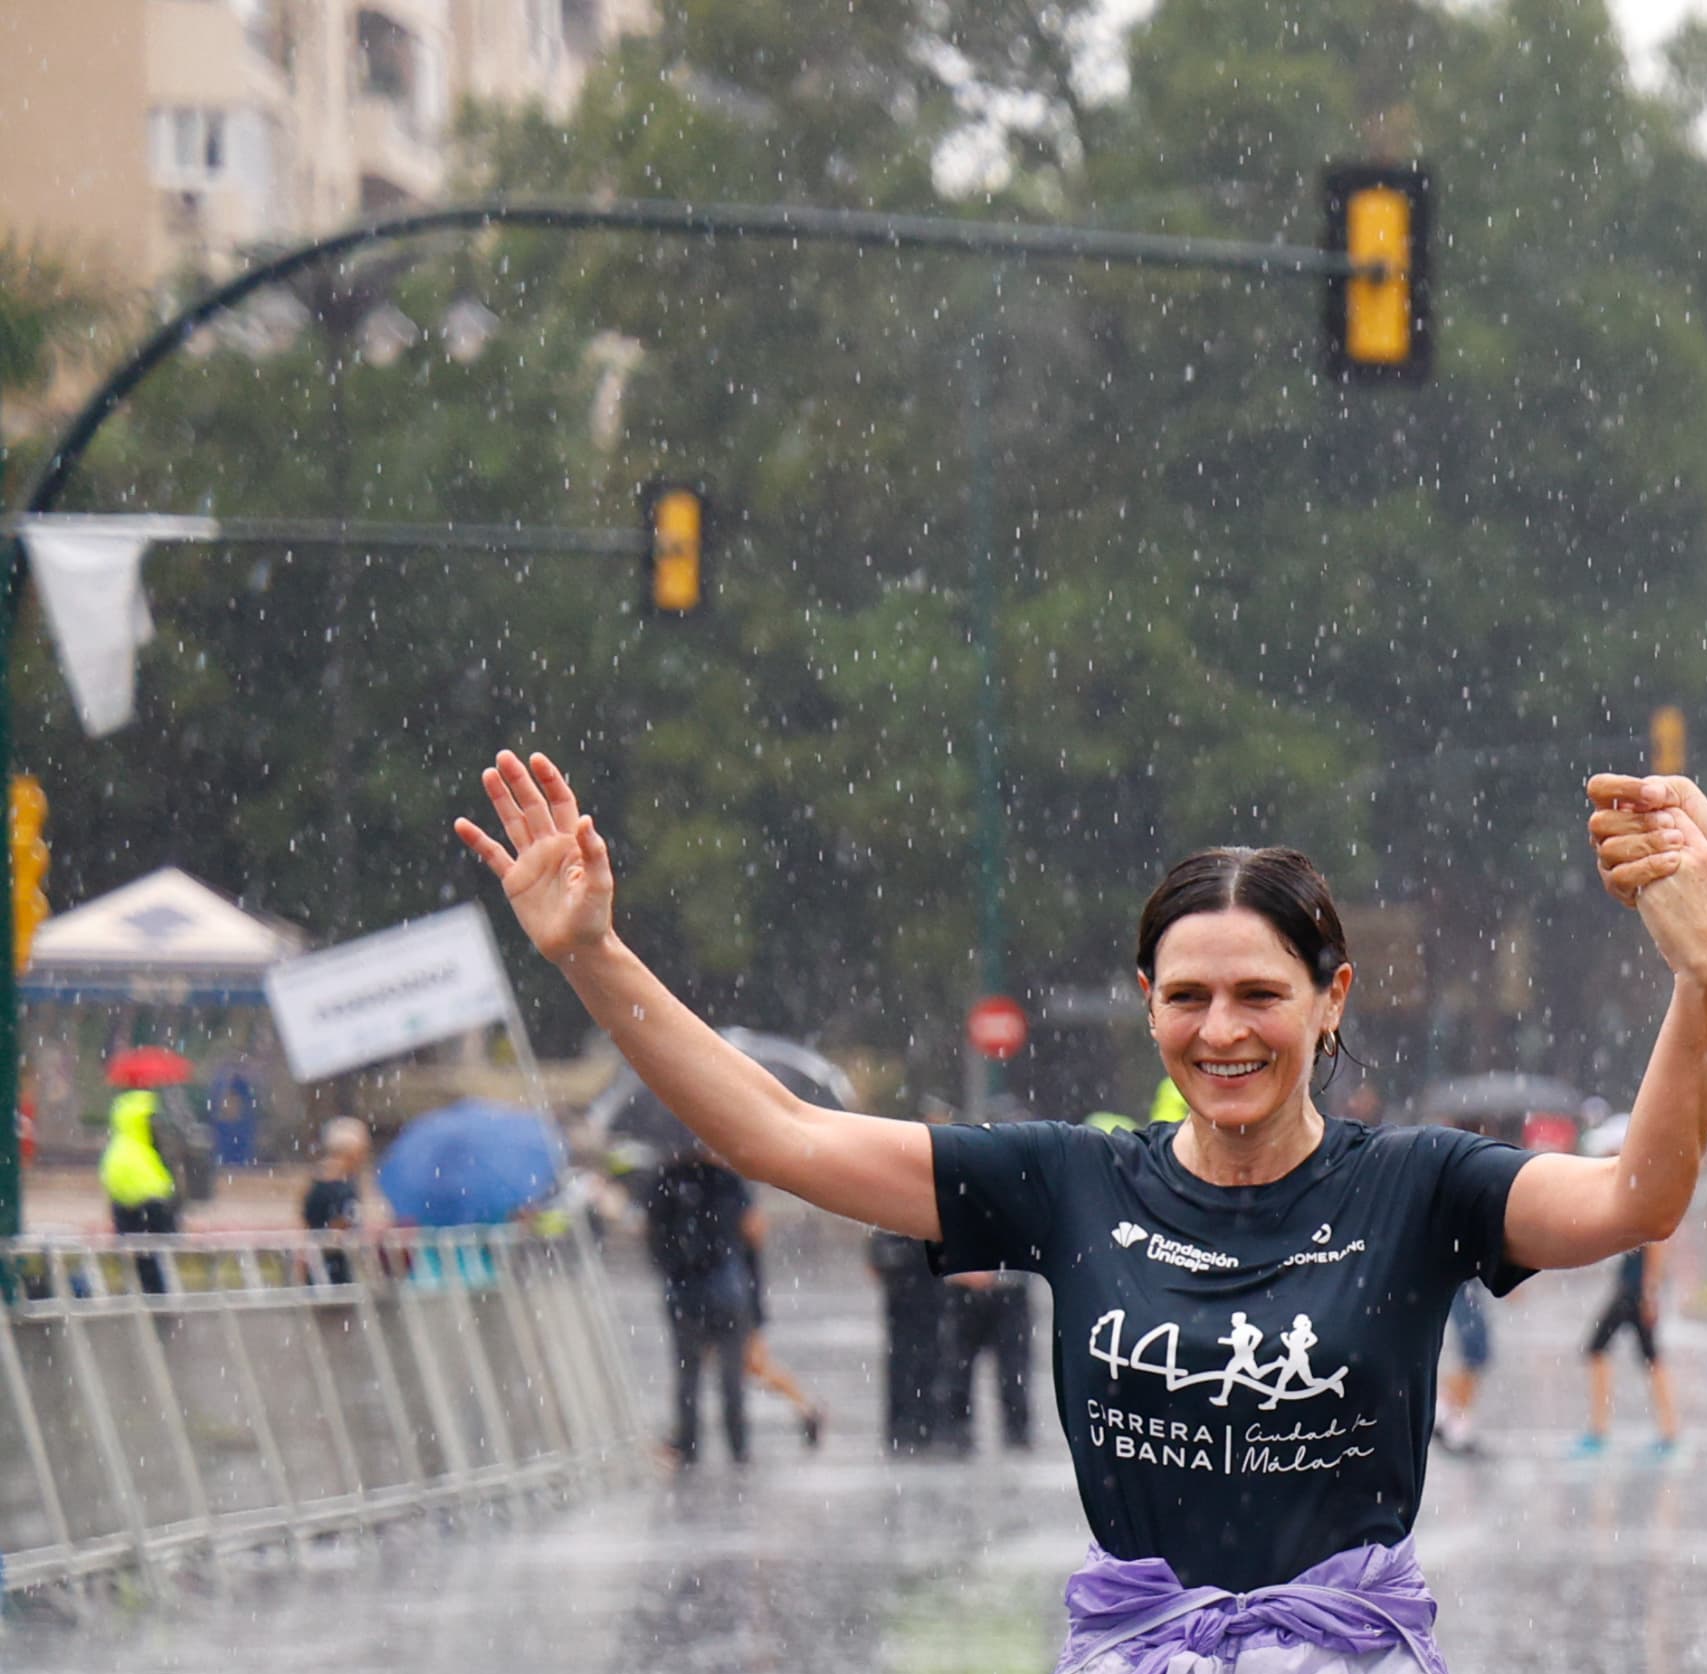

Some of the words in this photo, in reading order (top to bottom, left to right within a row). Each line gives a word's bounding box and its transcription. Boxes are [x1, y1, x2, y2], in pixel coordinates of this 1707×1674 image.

[1151, 1233, 1239, 1268] Fundación
[1087, 1400, 1214, 1444] CRRERA
[1245, 1419, 1347, 1442] Ciudad
[1090, 1425, 1214, 1471] UBANA
[1242, 1444, 1375, 1474] Málaa
